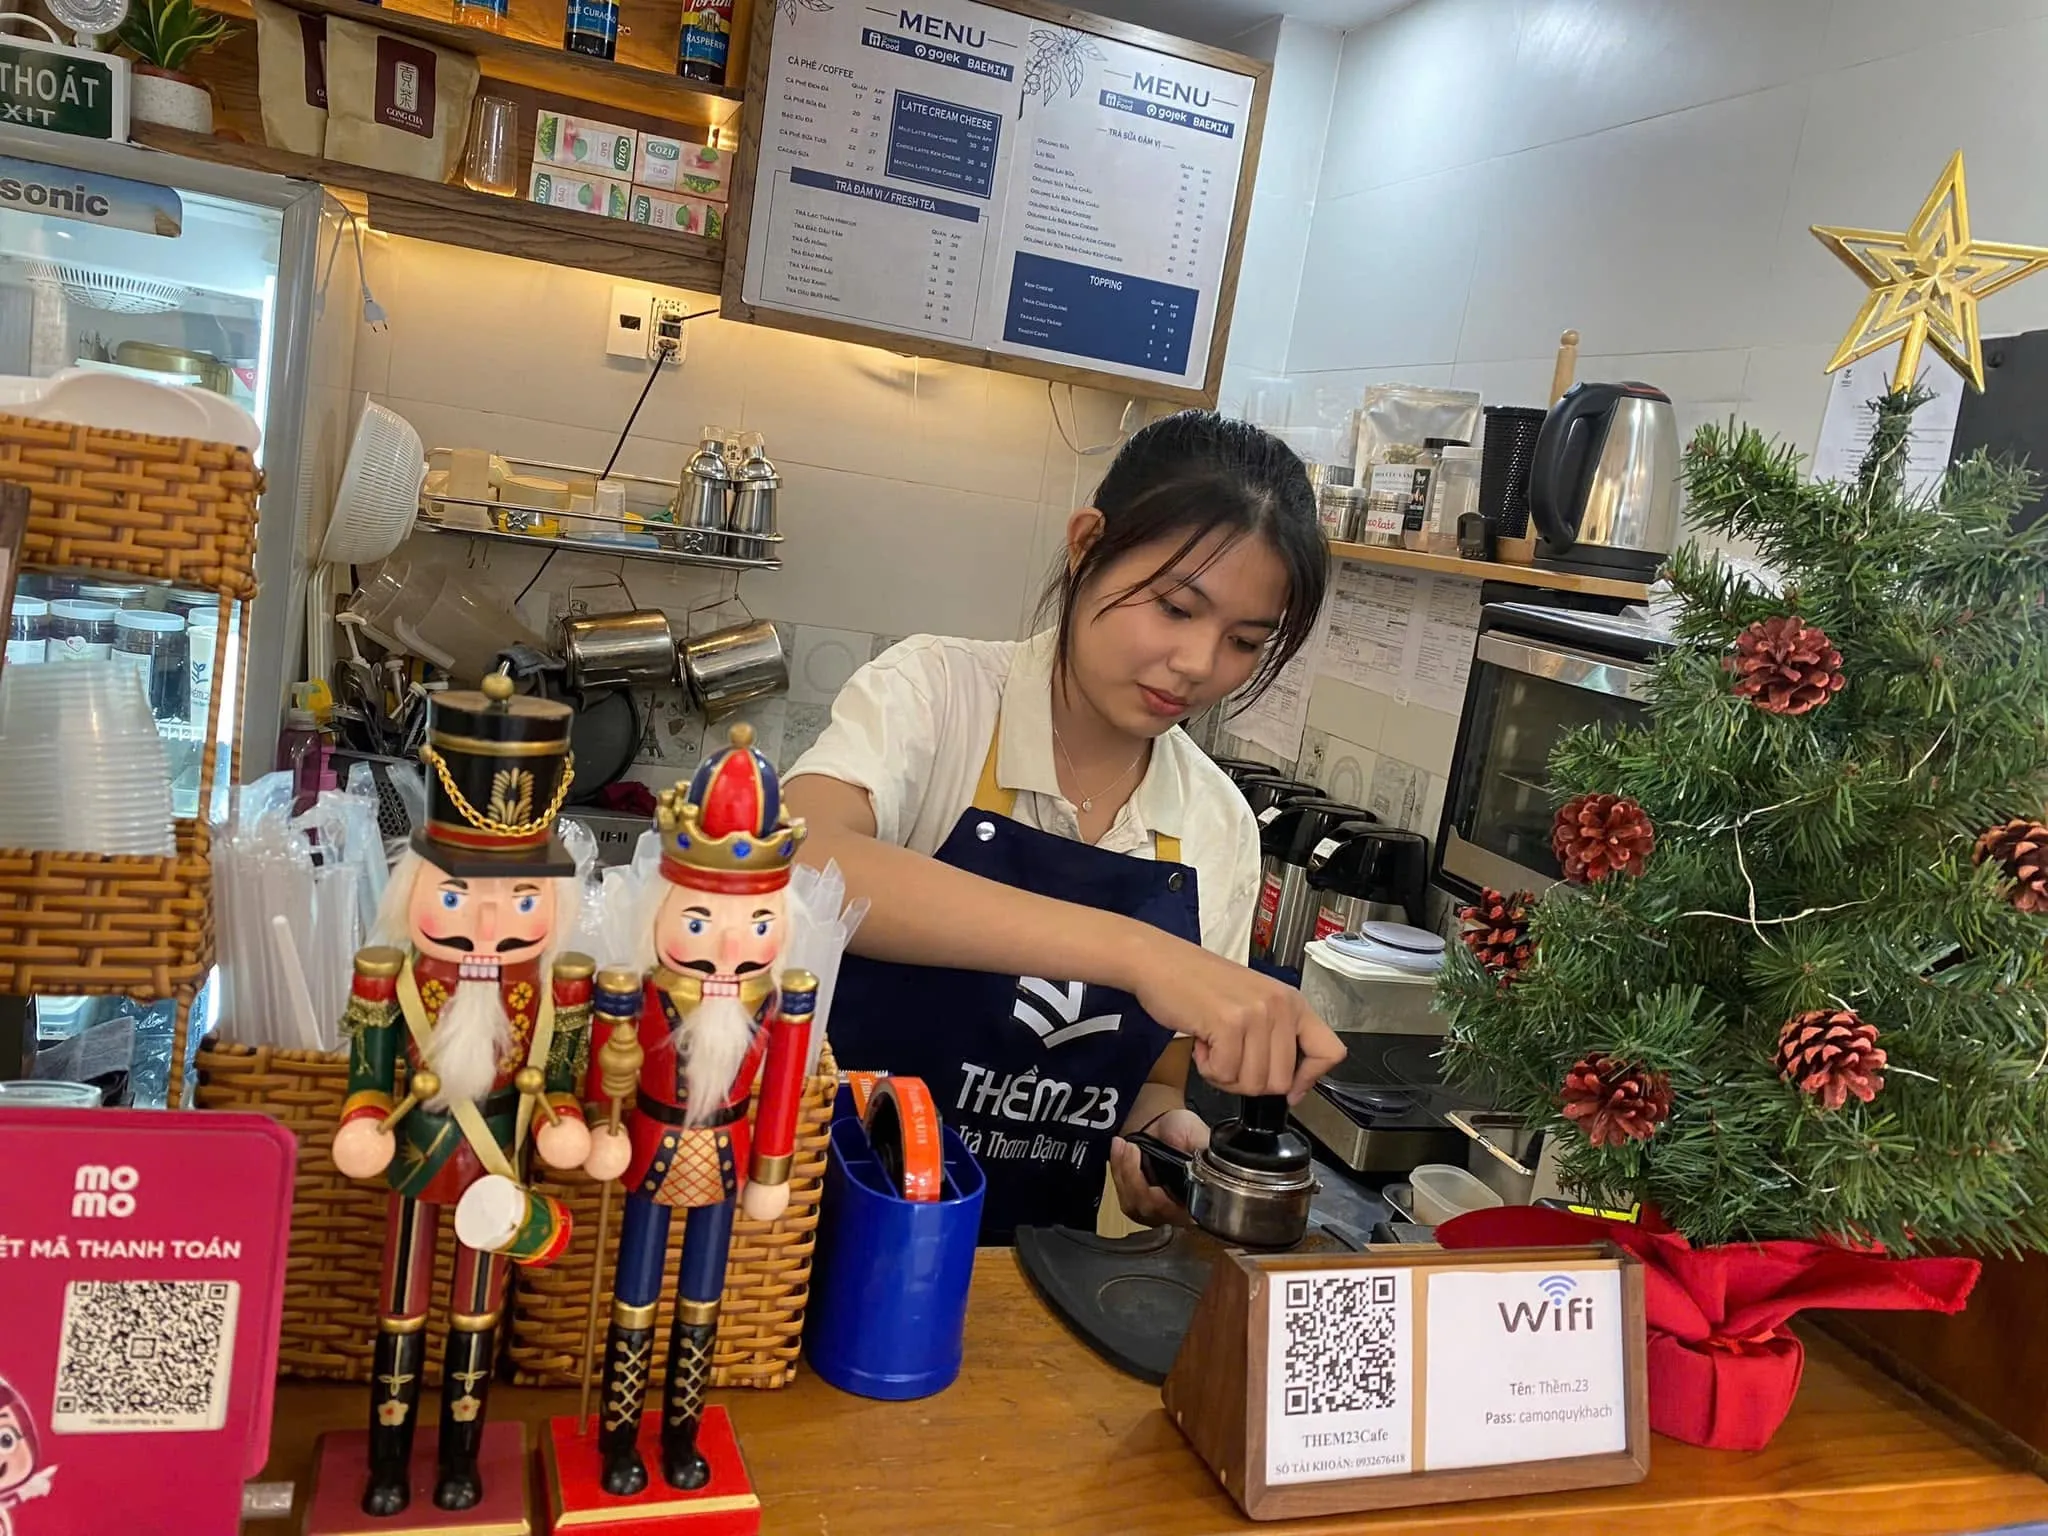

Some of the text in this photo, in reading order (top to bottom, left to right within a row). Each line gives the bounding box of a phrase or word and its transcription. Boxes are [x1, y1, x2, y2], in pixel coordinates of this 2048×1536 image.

[899, 9, 986, 49] MENU
[927, 48, 960, 64] gojek
[967, 58, 1007, 77] BAEMIN
[0, 62, 100, 109] THOÁT
[1134, 72, 1211, 107] MENU
[901, 99, 992, 131] LATTE CREAM CHEESE
[1158, 108, 1187, 122] gojek
[1192, 116, 1229, 134] BAEMIN
[614, 138, 631, 169] Cozy
[648, 143, 677, 159] Cozy
[0, 177, 110, 217] sonic
[835, 180, 852, 193] TRÀ
[890, 192, 919, 207] FRESH
[919, 198, 935, 211] TEA
[1090, 275, 1122, 291] TOPPING
[959, 1125, 982, 1155] Trà
[1071, 1139, 1090, 1170] Vị
[30, 1235, 71, 1259] MÃ
[76, 1239, 165, 1259] THANH
[171, 1235, 243, 1260] TOÁN
[1499, 1297, 1594, 1333] Wifi
[1509, 1382, 1537, 1396] Tên:
[1485, 1403, 1613, 1425] Pass: camonquykhach
[1302, 1428, 1390, 1449] THEM23Cafe
